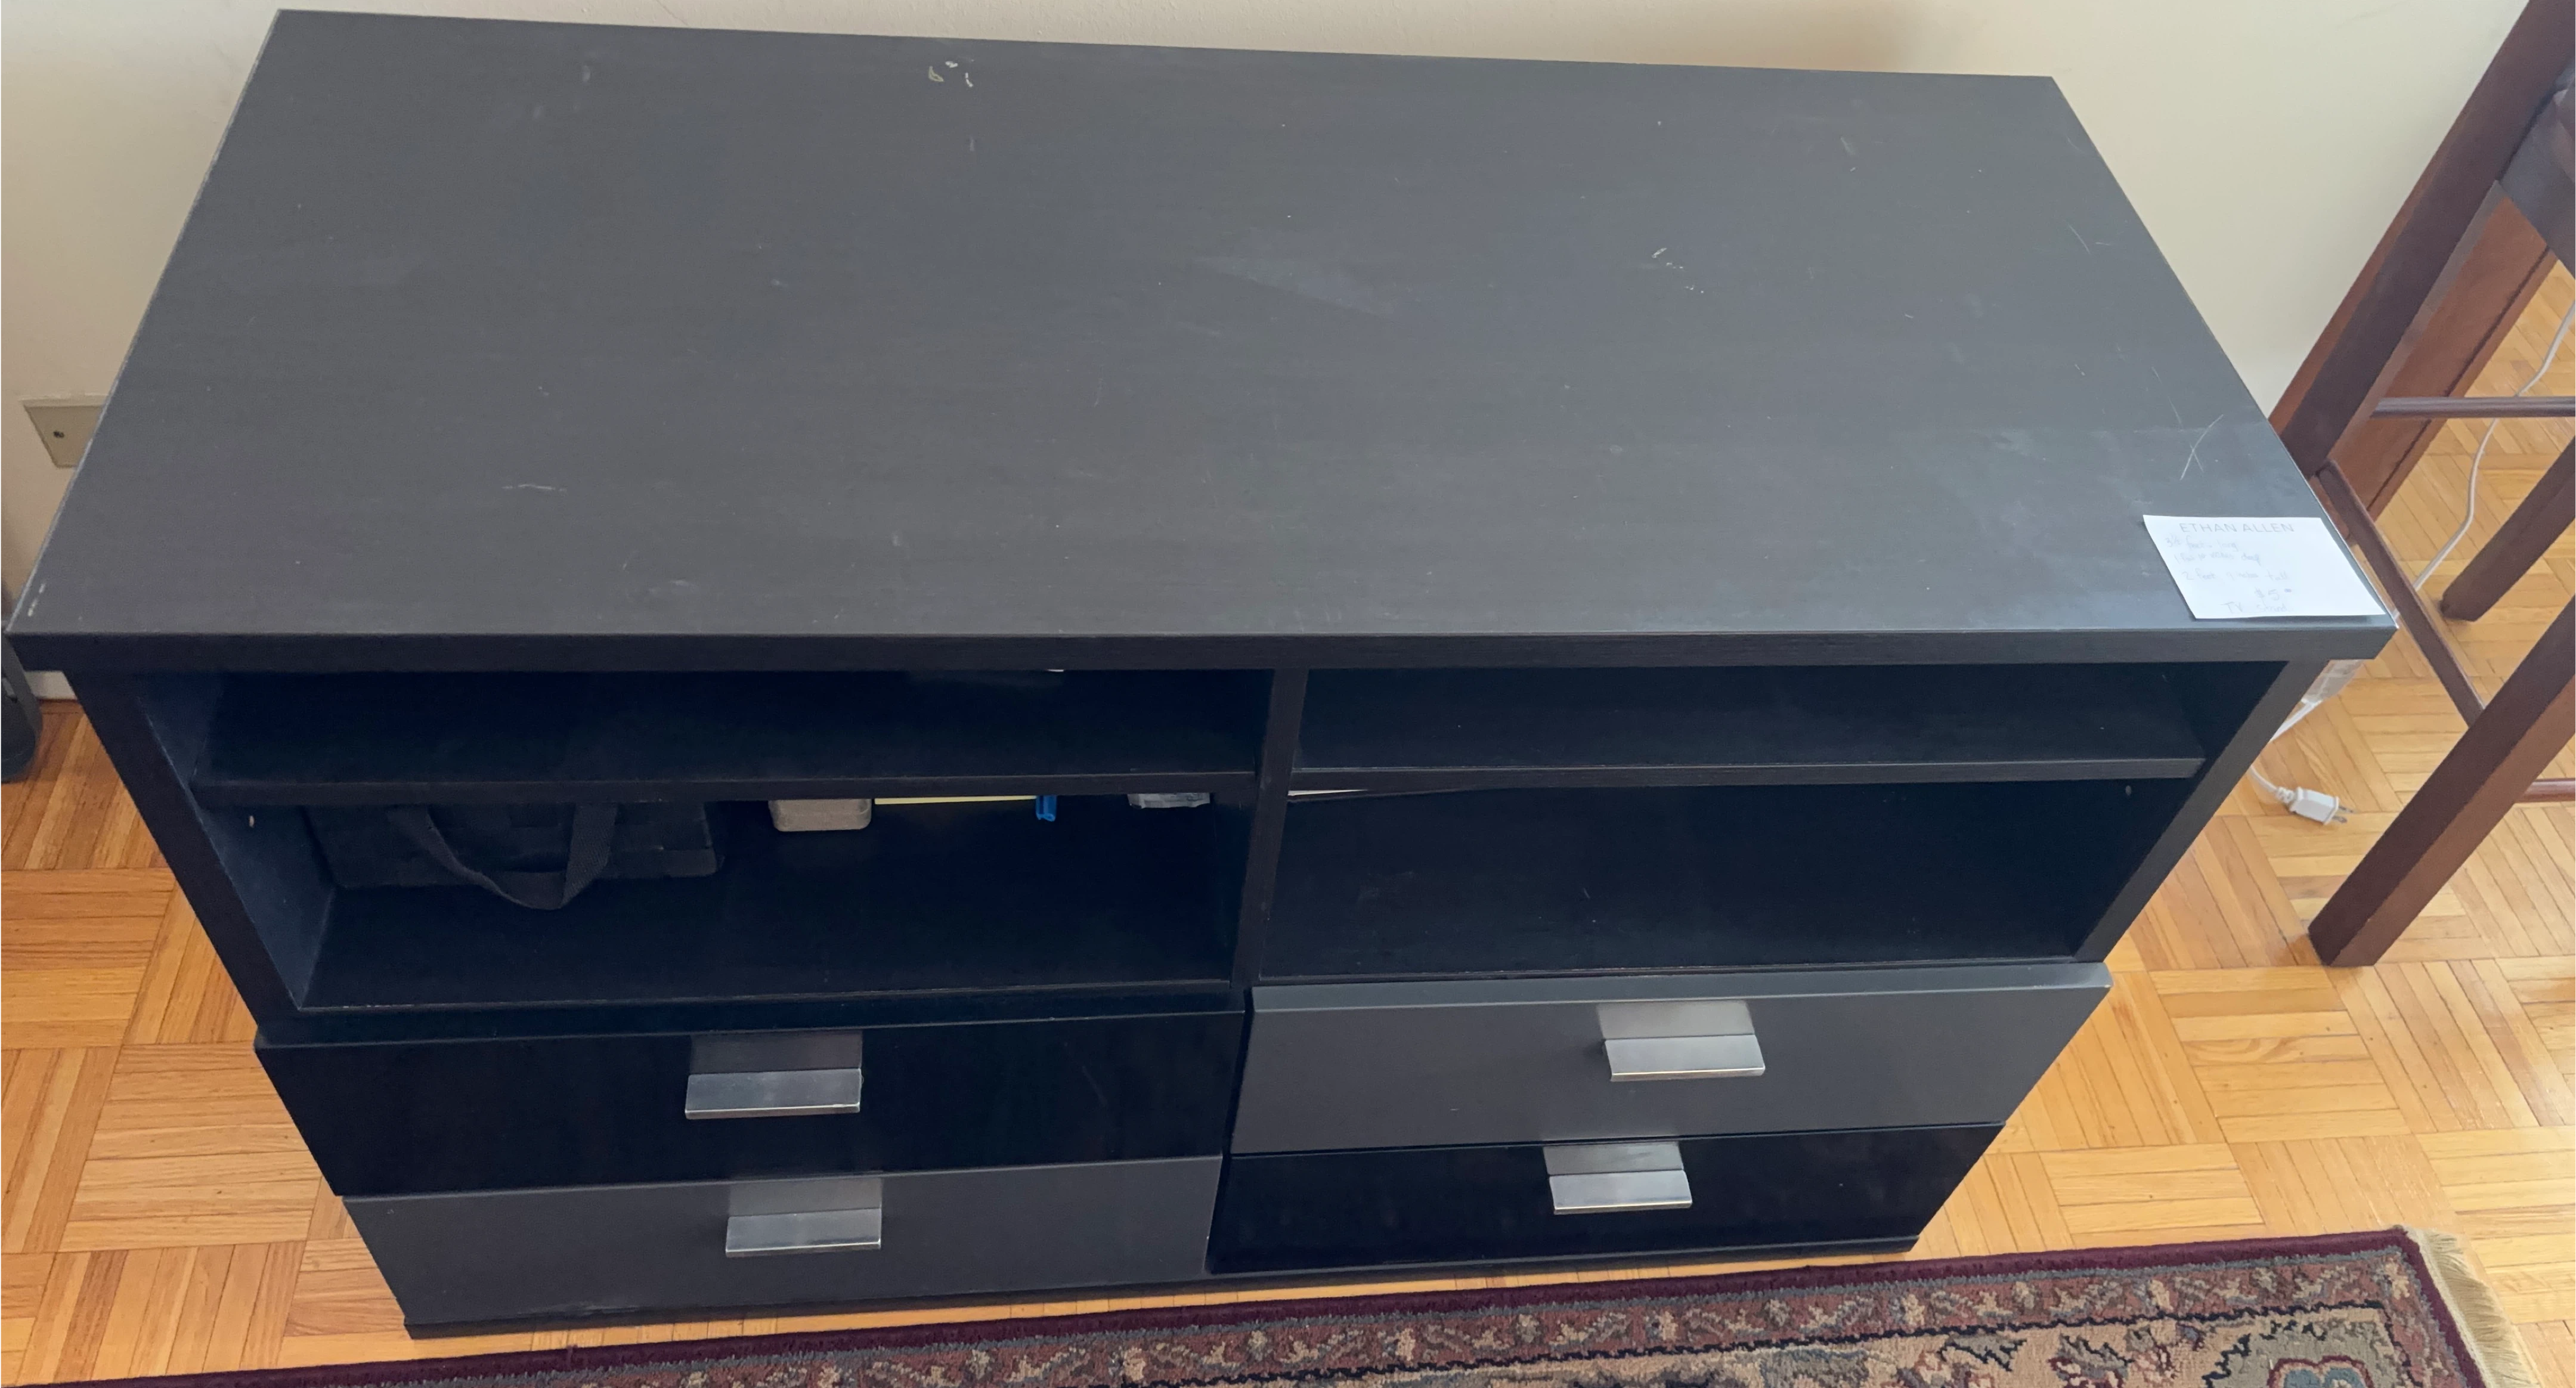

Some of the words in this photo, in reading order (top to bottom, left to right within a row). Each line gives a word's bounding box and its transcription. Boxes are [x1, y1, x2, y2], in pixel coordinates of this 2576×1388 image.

[2179, 523, 2237, 533] ETHAN
[2243, 523, 2295, 532] ALLEN
[2181, 571, 2194, 581] 2
[2264, 569, 2290, 581] tall
[2220, 601, 2244, 614] TV
